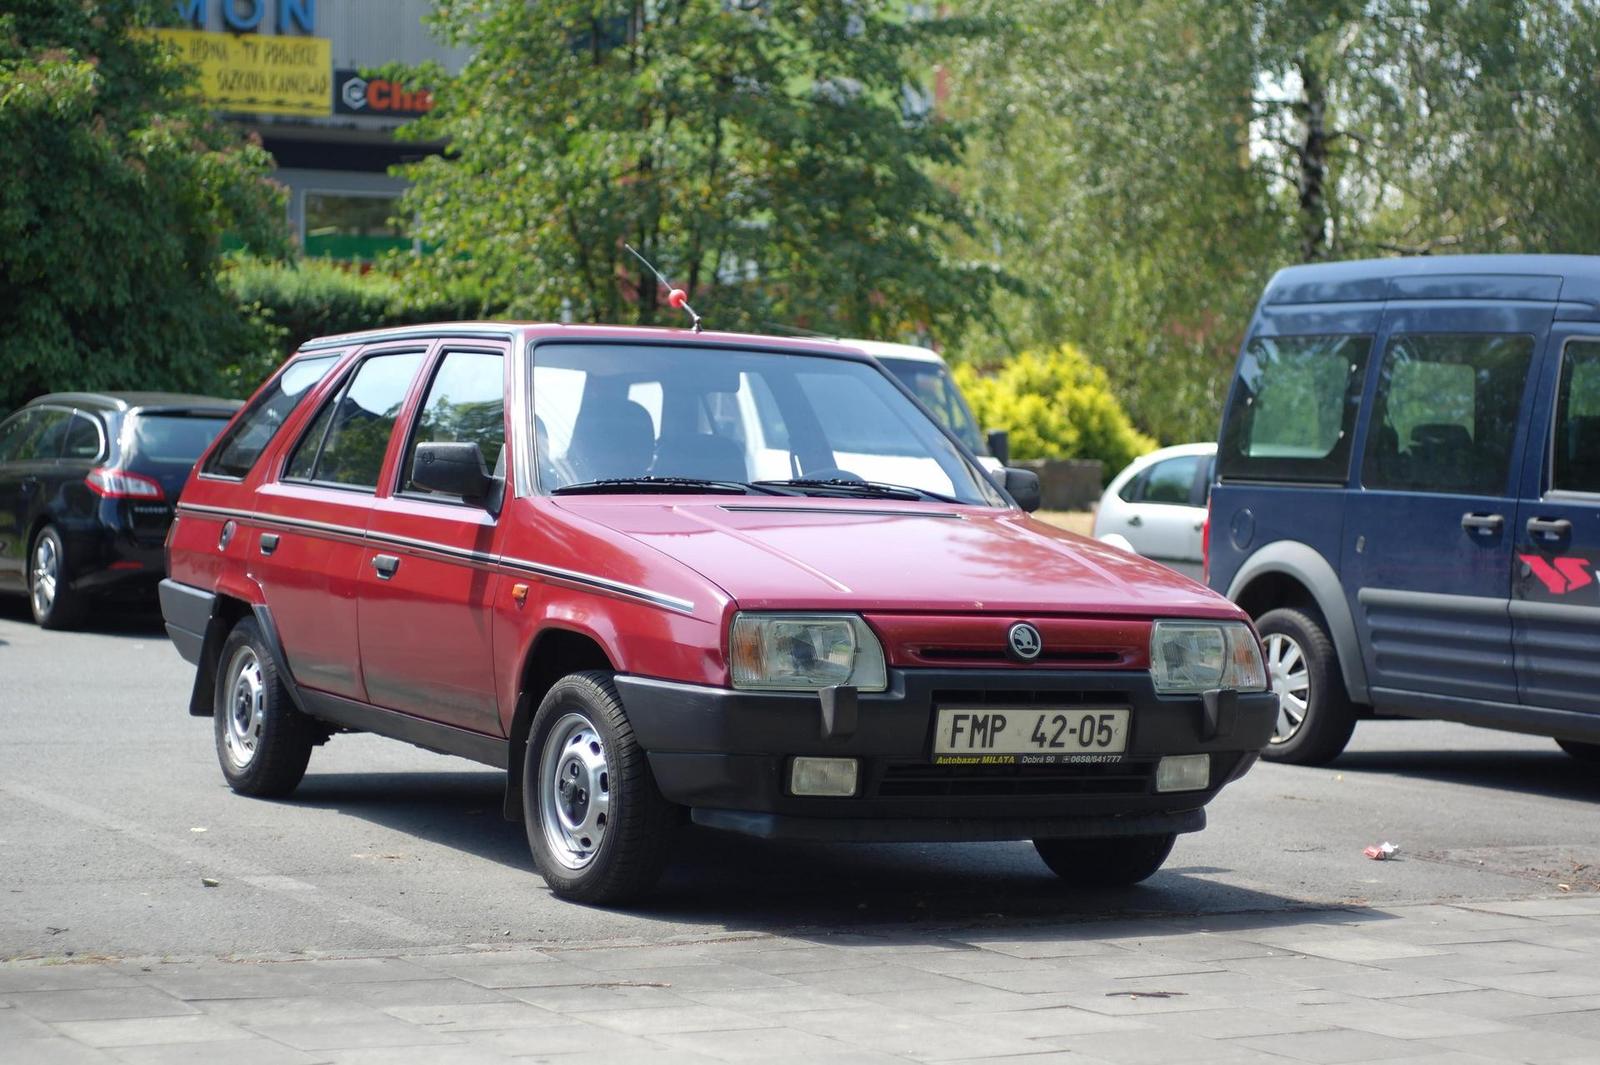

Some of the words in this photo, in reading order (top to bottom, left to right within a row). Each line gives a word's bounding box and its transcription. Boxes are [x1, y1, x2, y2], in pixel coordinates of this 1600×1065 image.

[950, 714, 1007, 748] FMP
[1031, 714, 1115, 748] 42-05
[936, 755, 980, 765] Autobazar
[981, 755, 1015, 764] MILATA
